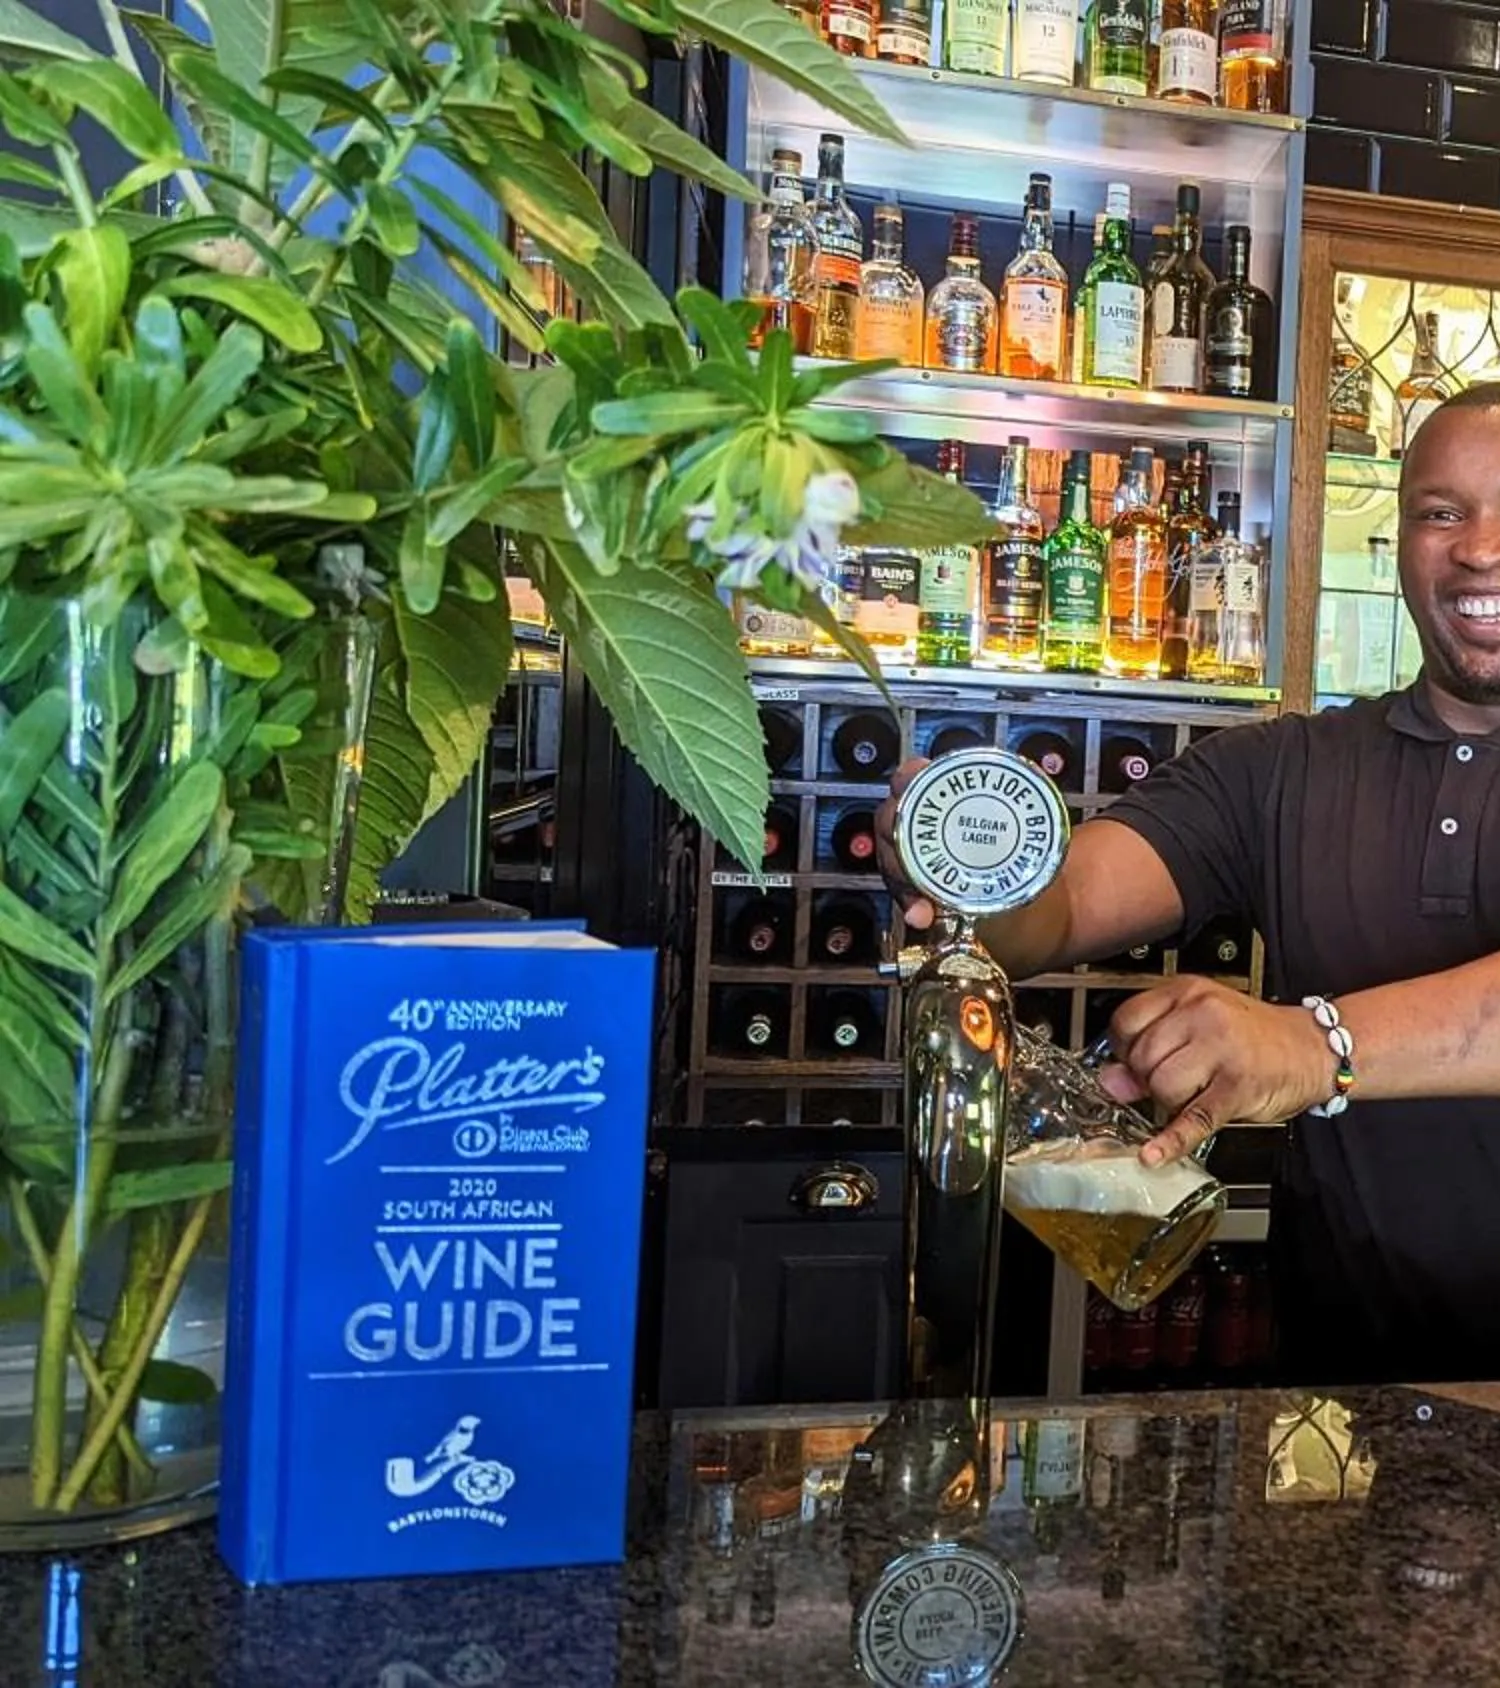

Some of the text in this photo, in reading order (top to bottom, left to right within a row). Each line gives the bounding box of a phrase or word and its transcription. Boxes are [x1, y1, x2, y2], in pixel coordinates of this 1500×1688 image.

[1042, 23, 1057, 37] 12
[871, 565, 915, 581] BAIN'S
[1049, 555, 1103, 576] JAMESON
[957, 815, 1009, 833] BELGIAN
[447, 999, 569, 1018] ANNIVERSARY
[445, 1015, 521, 1032] EDITION
[448, 1177, 498, 1198] 2020
[383, 1199, 554, 1220] SOUTH AFRICAN
[373, 1236, 558, 1293] WINE
[343, 1297, 581, 1361] GUIDE
